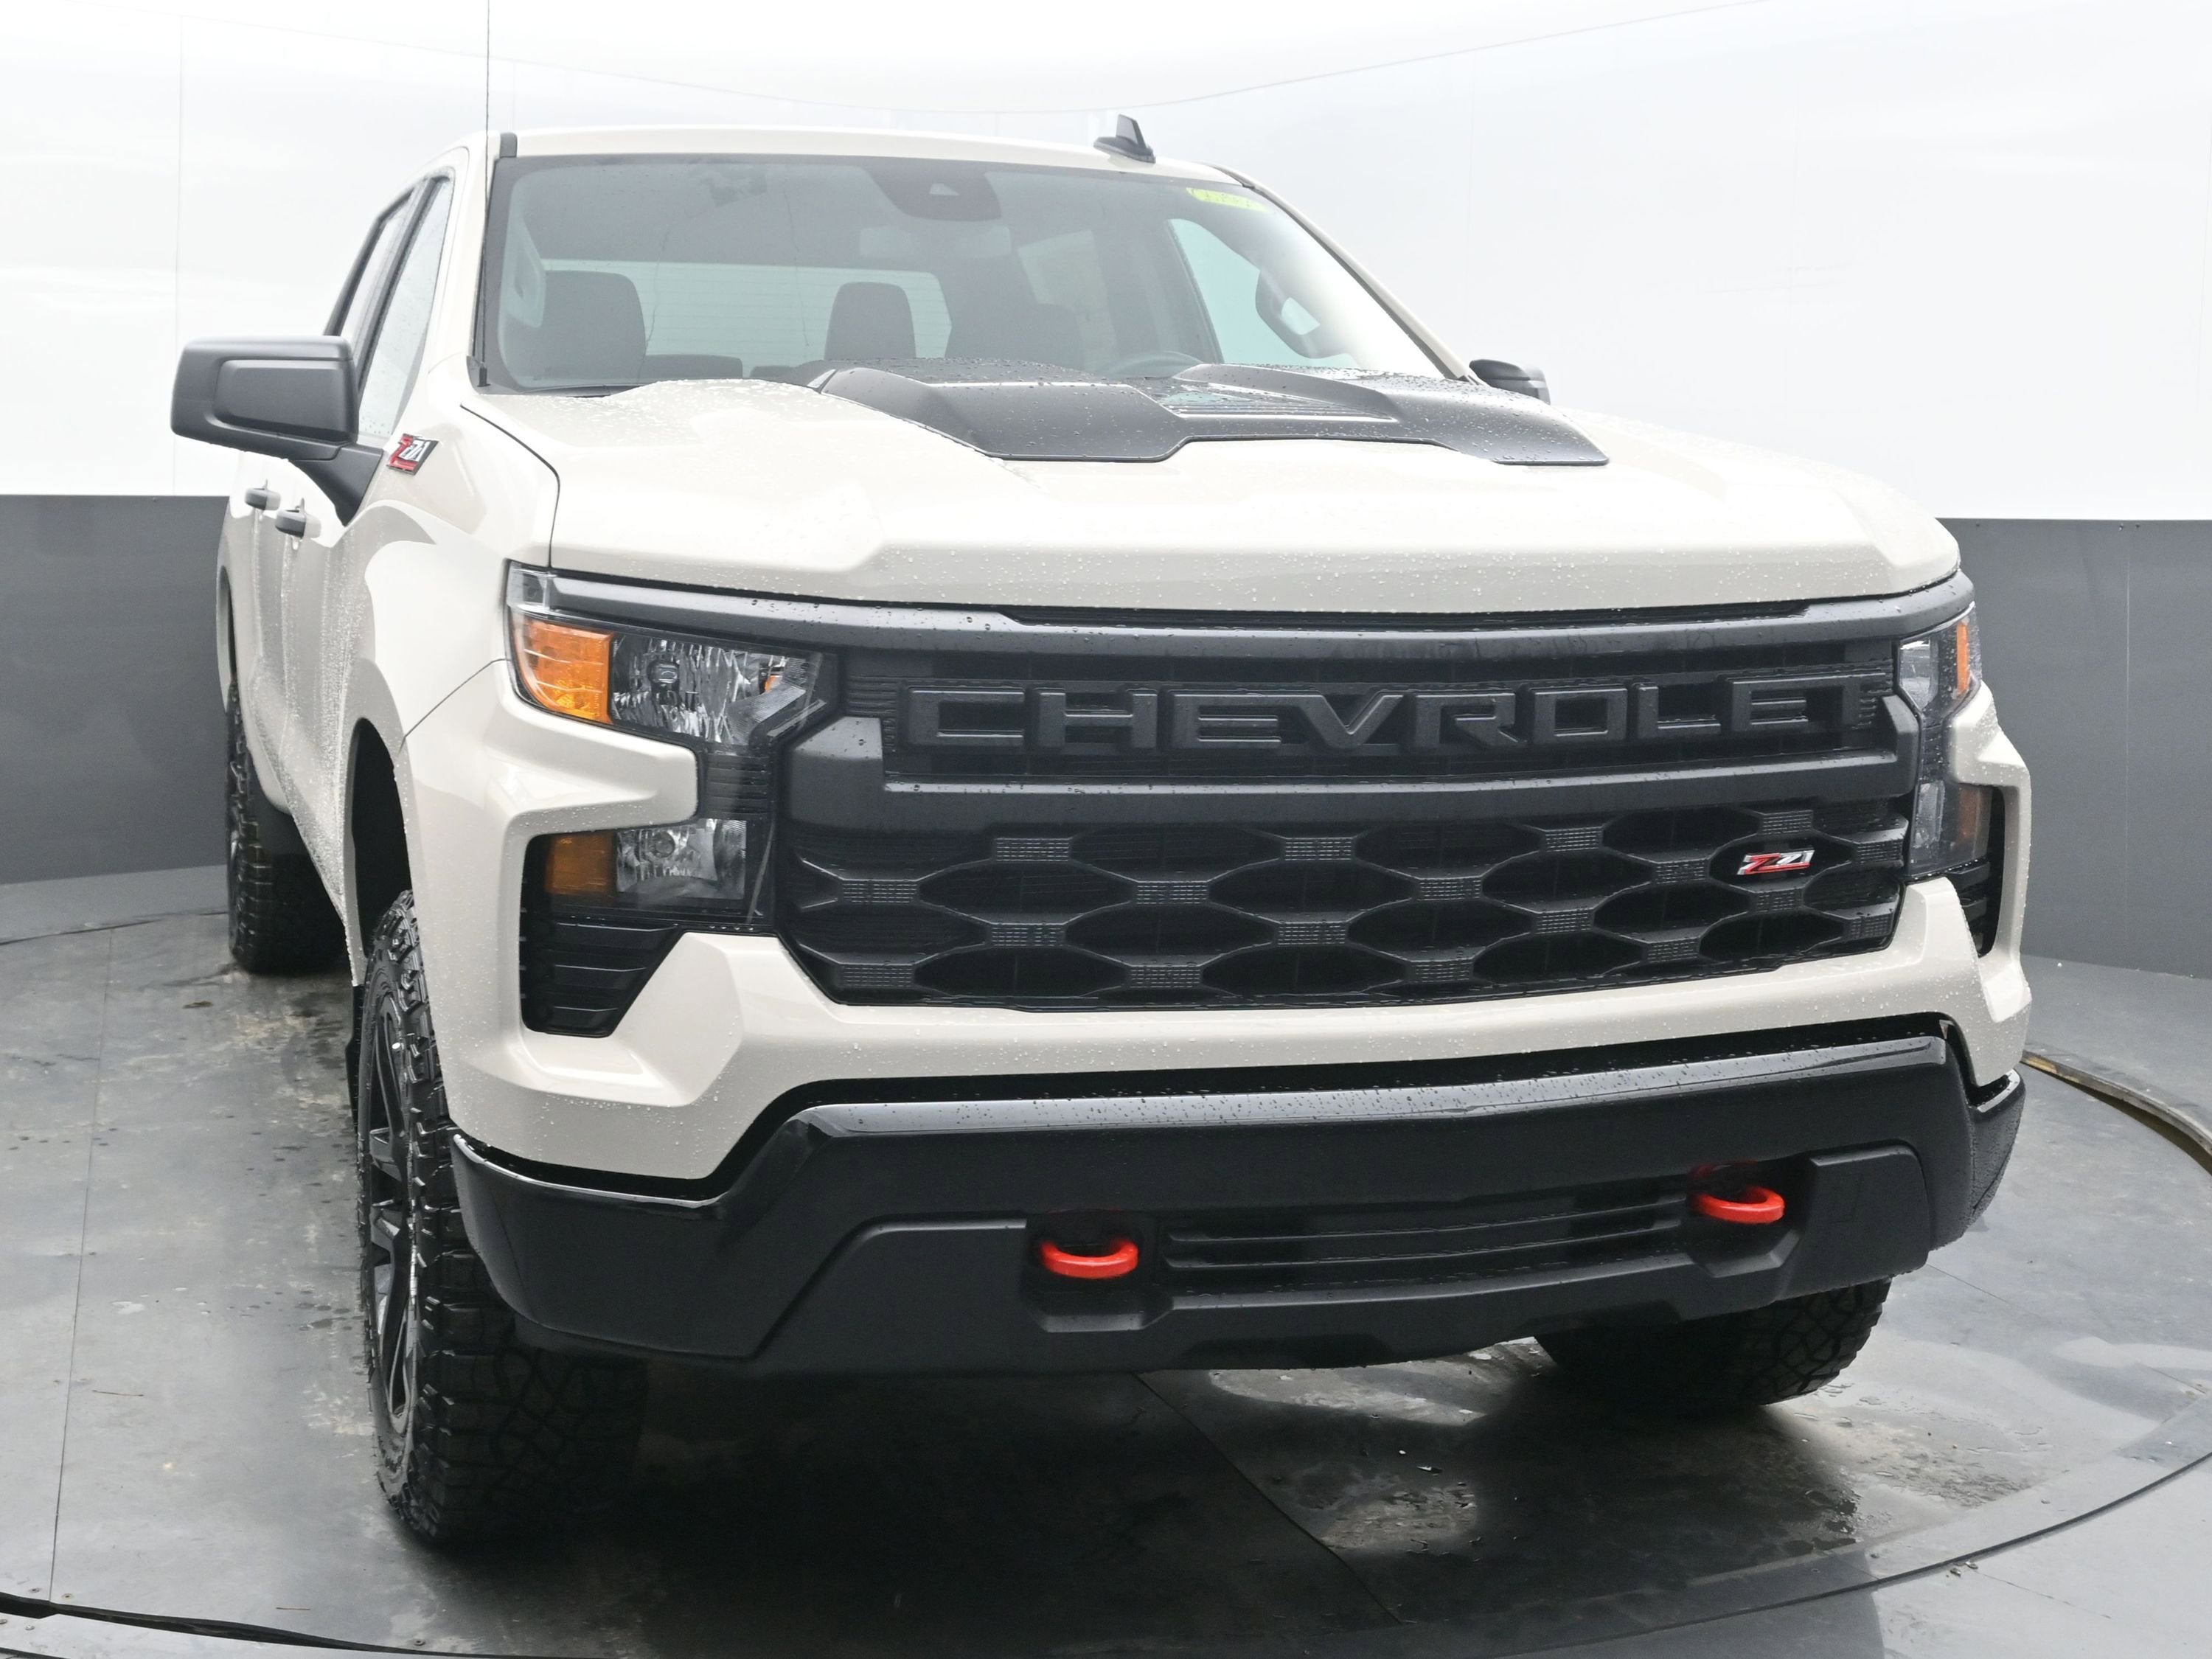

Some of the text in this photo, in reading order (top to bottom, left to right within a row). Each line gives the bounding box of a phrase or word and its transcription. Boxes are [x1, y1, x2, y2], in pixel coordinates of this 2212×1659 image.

[387, 434, 439, 476] Z71
[907, 672, 1886, 750] CHEVROLET
[1736, 849, 1815, 875] Z71
